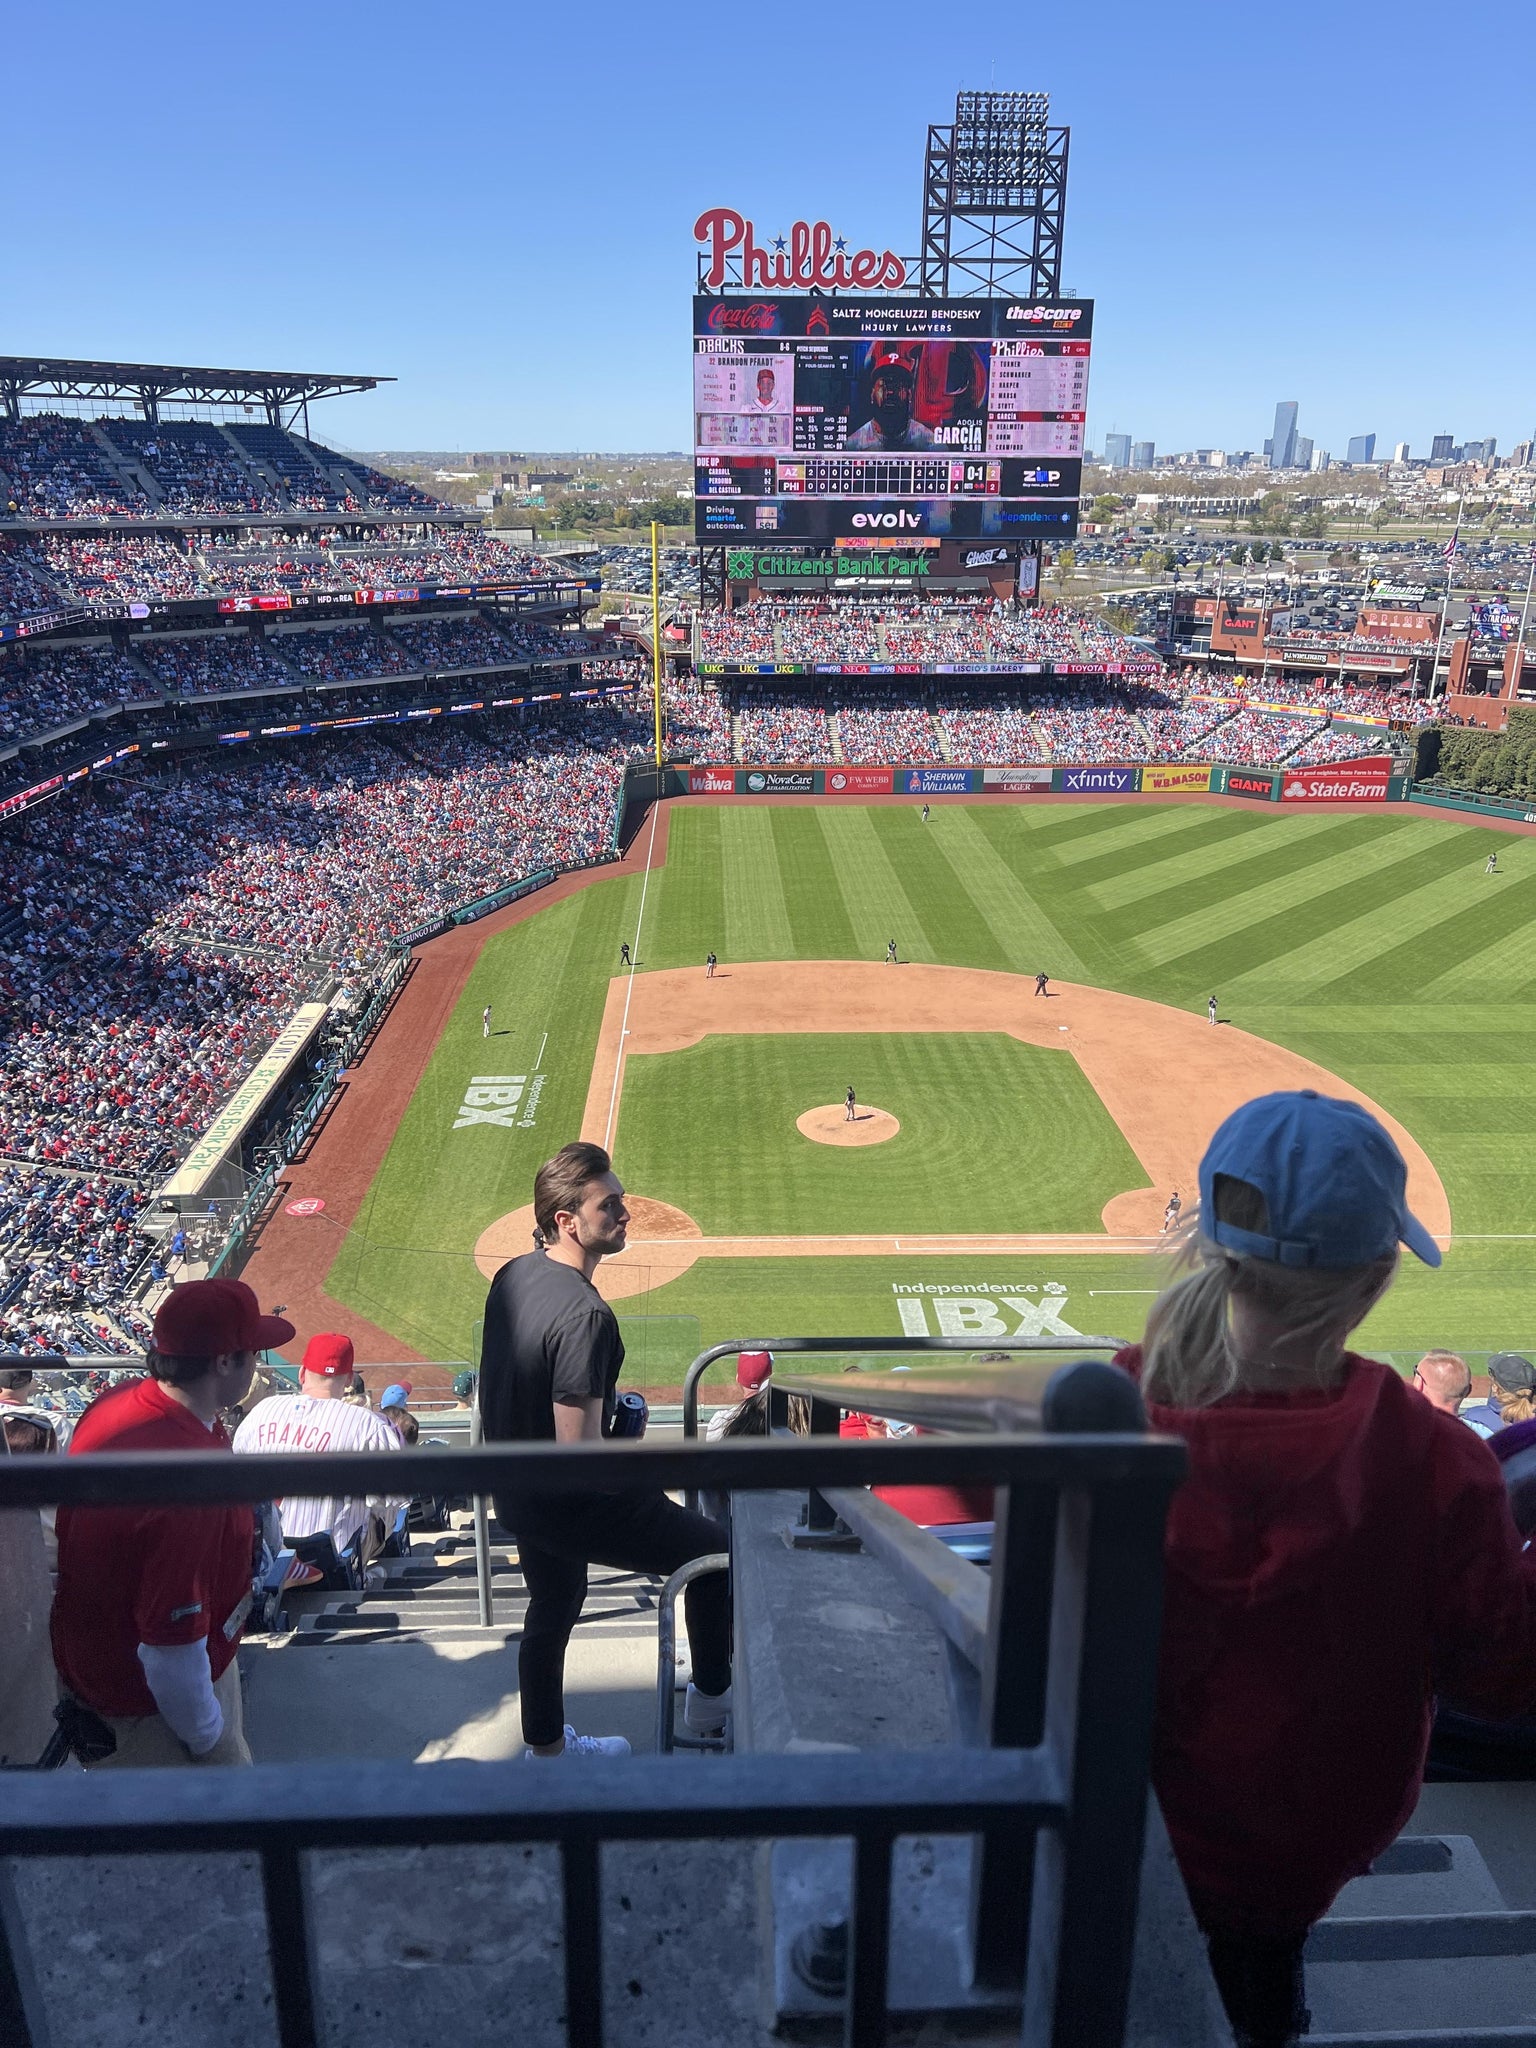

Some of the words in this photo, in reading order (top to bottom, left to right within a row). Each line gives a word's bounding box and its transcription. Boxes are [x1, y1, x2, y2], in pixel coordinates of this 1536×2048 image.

[694, 207, 906, 290] Phillies
[833, 309, 861, 318] SALTZ
[865, 309, 927, 319] MONGELUZZI
[931, 310, 981, 319] BENDESKY
[1006, 306, 1082, 320] theScore
[906, 324, 952, 332] LAWYERS
[992, 341, 1044, 356] Phillies
[718, 358, 748, 366] BRANDON
[934, 425, 982, 444] GARCÍA
[696, 457, 709, 466] DUE
[711, 457, 719, 467] UP
[784, 468, 798, 476] AZ
[967, 465, 983, 480] 0-1
[783, 482, 799, 491] PHI
[706, 506, 735, 514] Driving
[852, 509, 922, 527] evolv
[965, 548, 1000, 567] GHOST
[758, 556, 834, 575] Citizens
[838, 556, 885, 575] Bank
[888, 556, 930, 575] Park
[1375, 580, 1427, 595] Fitzpatrick
[1482, 613, 1500, 622] STAR
[1500, 614, 1520, 624] GAME
[704, 664, 724, 673] UKG
[739, 665, 759, 673] UKG
[774, 665, 794, 673] UKG
[844, 665, 867, 673] NECA
[898, 665, 920, 673] NECA
[766, 774, 813, 785] NovaCare
[923, 772, 965, 781] SHERWIN
[996, 770, 1040, 782] Yuengling
[1067, 769, 1128, 789] xfinity
[691, 777, 732, 791] Wawa
[1228, 777, 1272, 794] GIANT
[401, 927, 429, 945] GRUNGO
[268, 1016, 318, 1060] WELCOME
[226, 1078, 270, 1119] Citizens
[452, 1075, 527, 1129] IBX
[205, 1118, 241, 1150] Bank
[184, 1147, 222, 1171] Park
[892, 1282, 1038, 1295] Independence
[896, 1297, 1085, 1337] IBX
[258, 1422, 331, 1452] FRANCO
